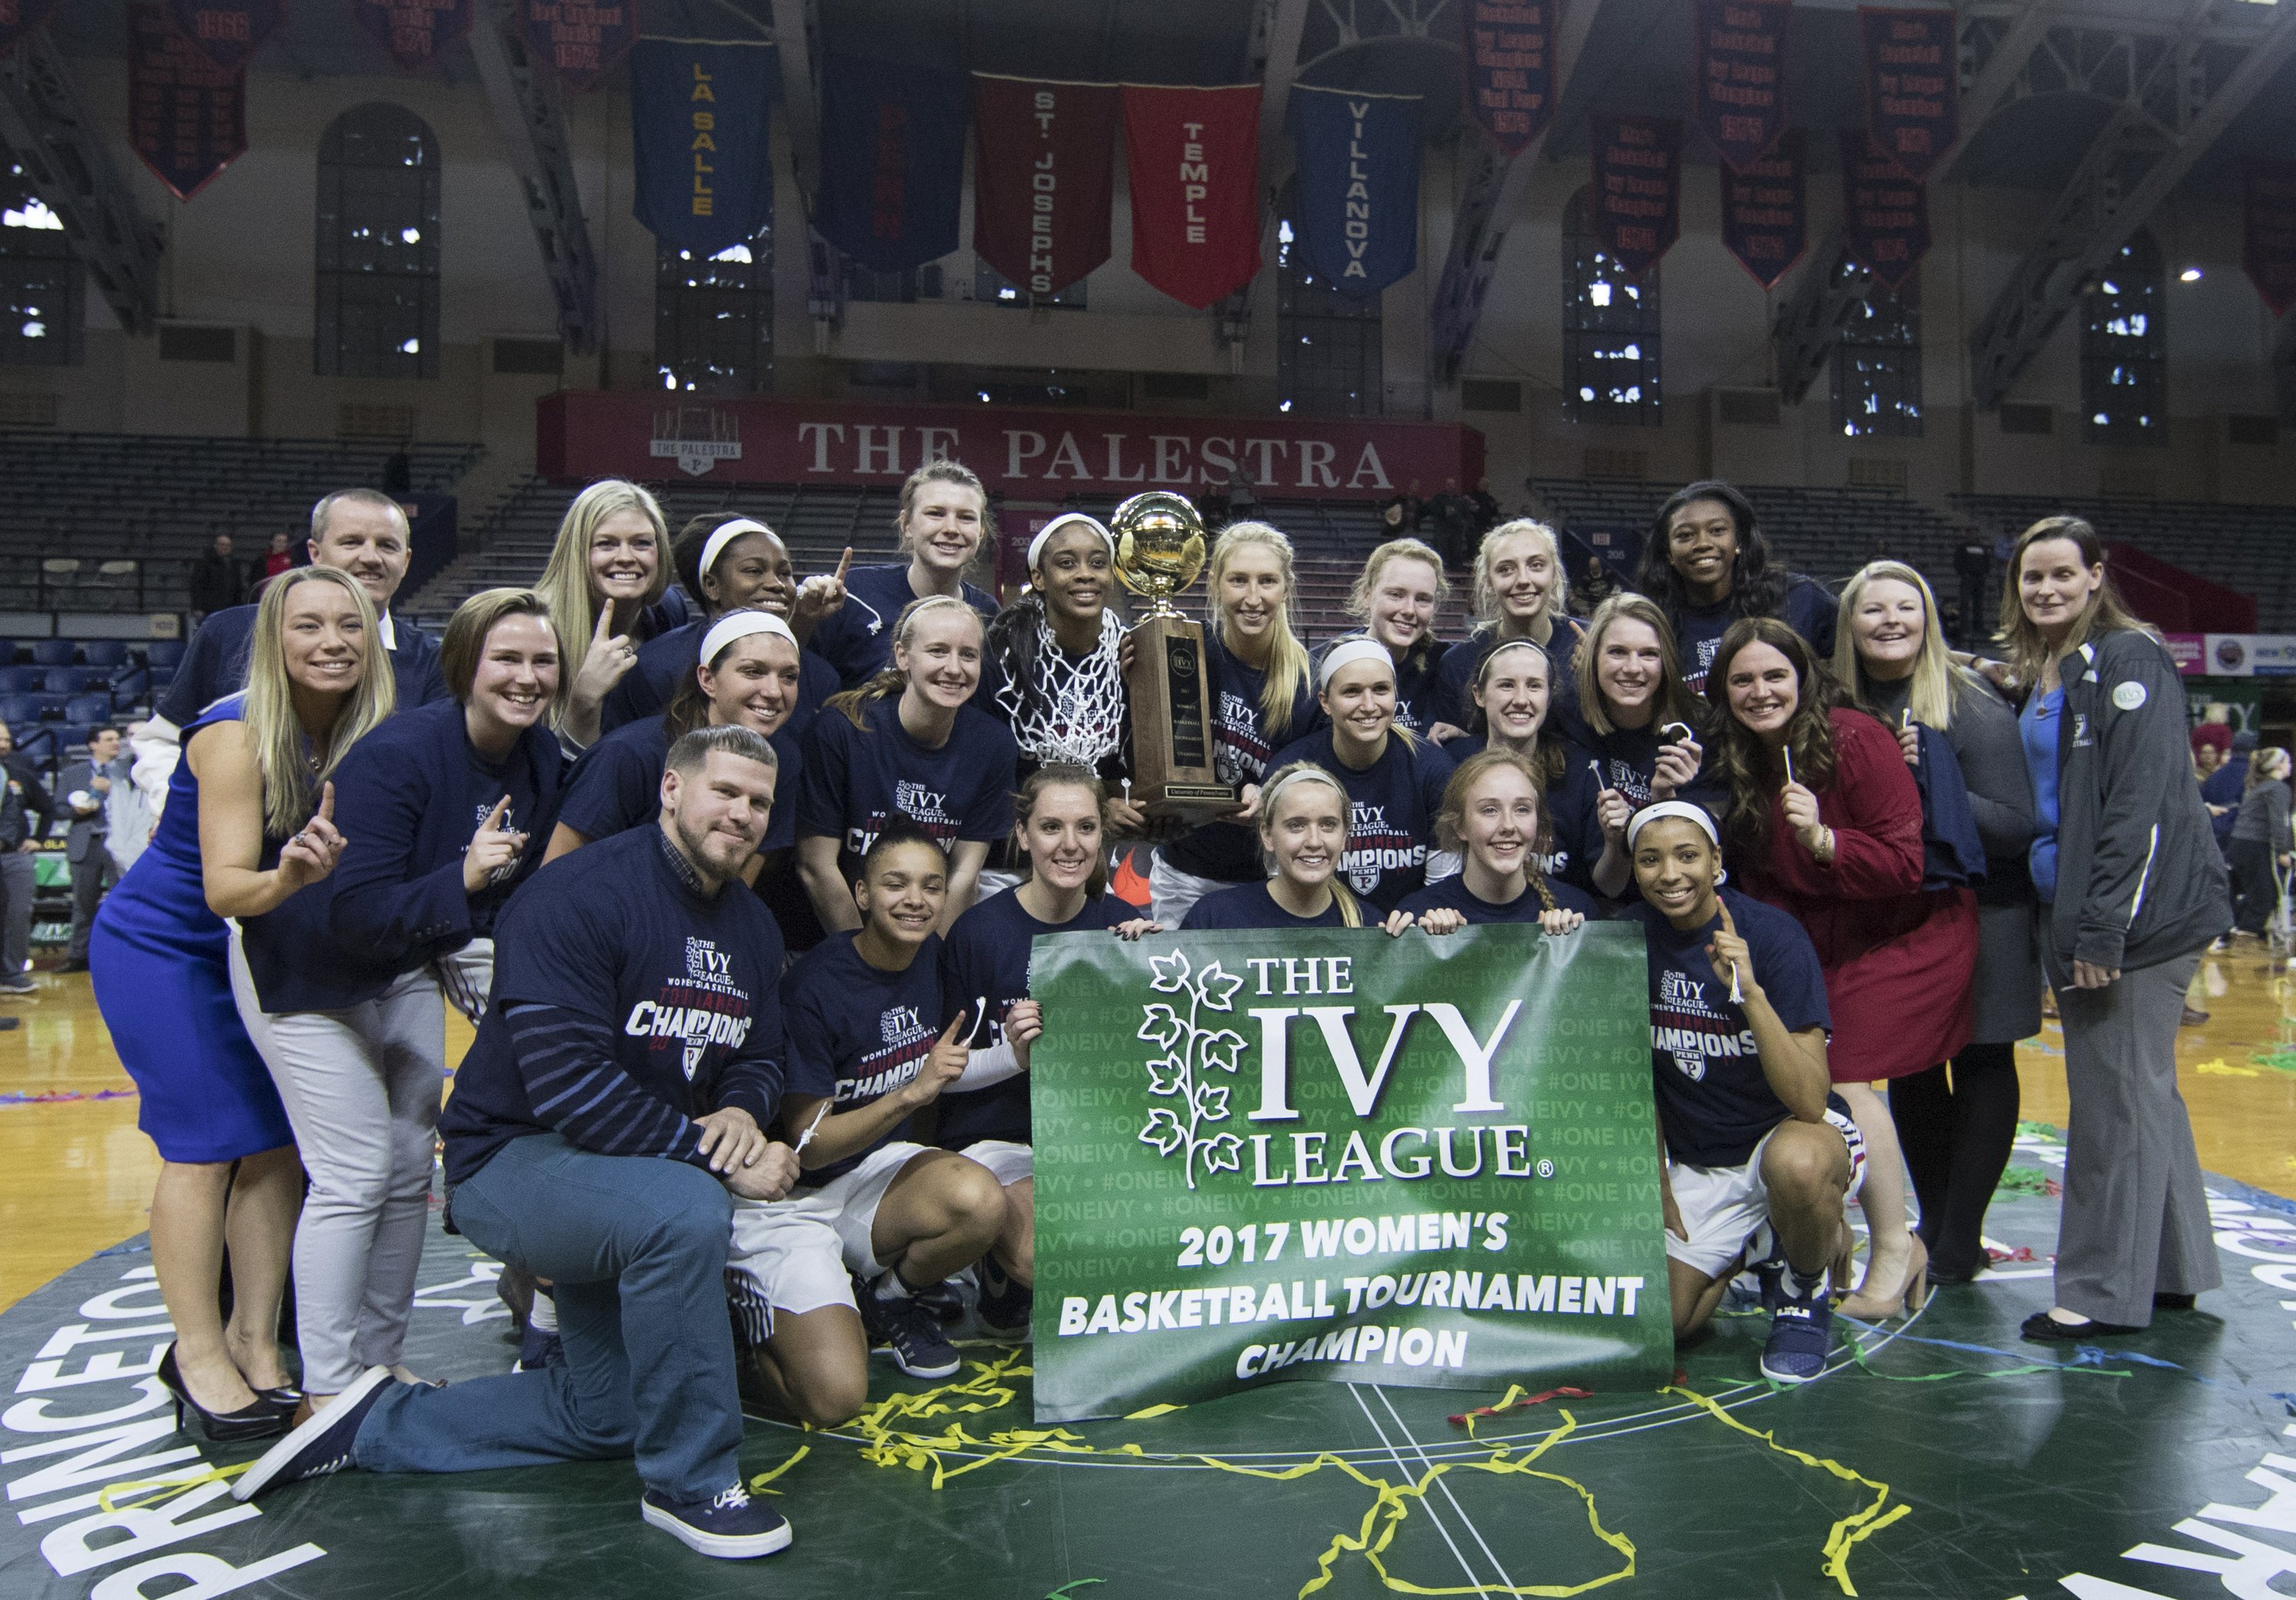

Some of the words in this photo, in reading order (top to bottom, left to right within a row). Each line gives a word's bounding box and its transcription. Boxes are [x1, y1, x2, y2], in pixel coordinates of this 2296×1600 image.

[691, 64, 716, 103] LA
[691, 112, 716, 217] SALLE
[1180, 122, 1208, 244] TEMPLE
[1344, 102, 1372, 279] VILLANOVA
[1029, 158, 1055, 293] JOSEPHS
[657, 442, 677, 455] THE
[681, 443, 735, 457] PALESTRA
[798, 422, 960, 475] THE
[1002, 429, 1394, 490] PALESTRA
[1231, 694, 1244, 704] THE
[1226, 701, 1259, 727] IVY
[911, 782, 926, 792] THE
[1621, 766, 1647, 787] IVY
[908, 791, 946, 809] IVY
[908, 805, 944, 817] LEAGUE
[1352, 805, 1384, 824] IVY
[1352, 821, 1386, 831] LEAGUE
[698, 939, 716, 949] THE
[698, 949, 732, 975] IVY
[1246, 956, 1354, 996] THE
[1673, 978, 1705, 1000] IVY
[891, 1005, 906, 1016] THE
[1672, 996, 1704, 1010] LEAGUE
[1676, 1005, 1730, 1021] BASKETBALL
[892, 1006, 919, 1034] IVY
[861, 1044, 898, 1063] WOMEN'S
[1247, 998, 1524, 1121] IVY
[1676, 1051, 1700, 1060] PENN
[1548, 1072, 1613, 1091] #ONE
[1551, 1127, 1616, 1147] #ONE
[1162, 1191, 1265, 1216] #ONEIVY
[1290, 1184, 1392, 1208] #ONEIVY
[1417, 1181, 1483, 1200] #ONE
[1490, 1181, 1528, 1200] IVY
[1554, 1182, 1619, 1202] #ONE
[1177, 1222, 1290, 1268] 2017
[1300, 1211, 1509, 1259] WOMEN'S
[1057, 1278, 1335, 1337] BASKETBALL
[1342, 1269, 1645, 1317] TOURNAMENT
[1234, 1324, 1469, 1380] CHAMPION
